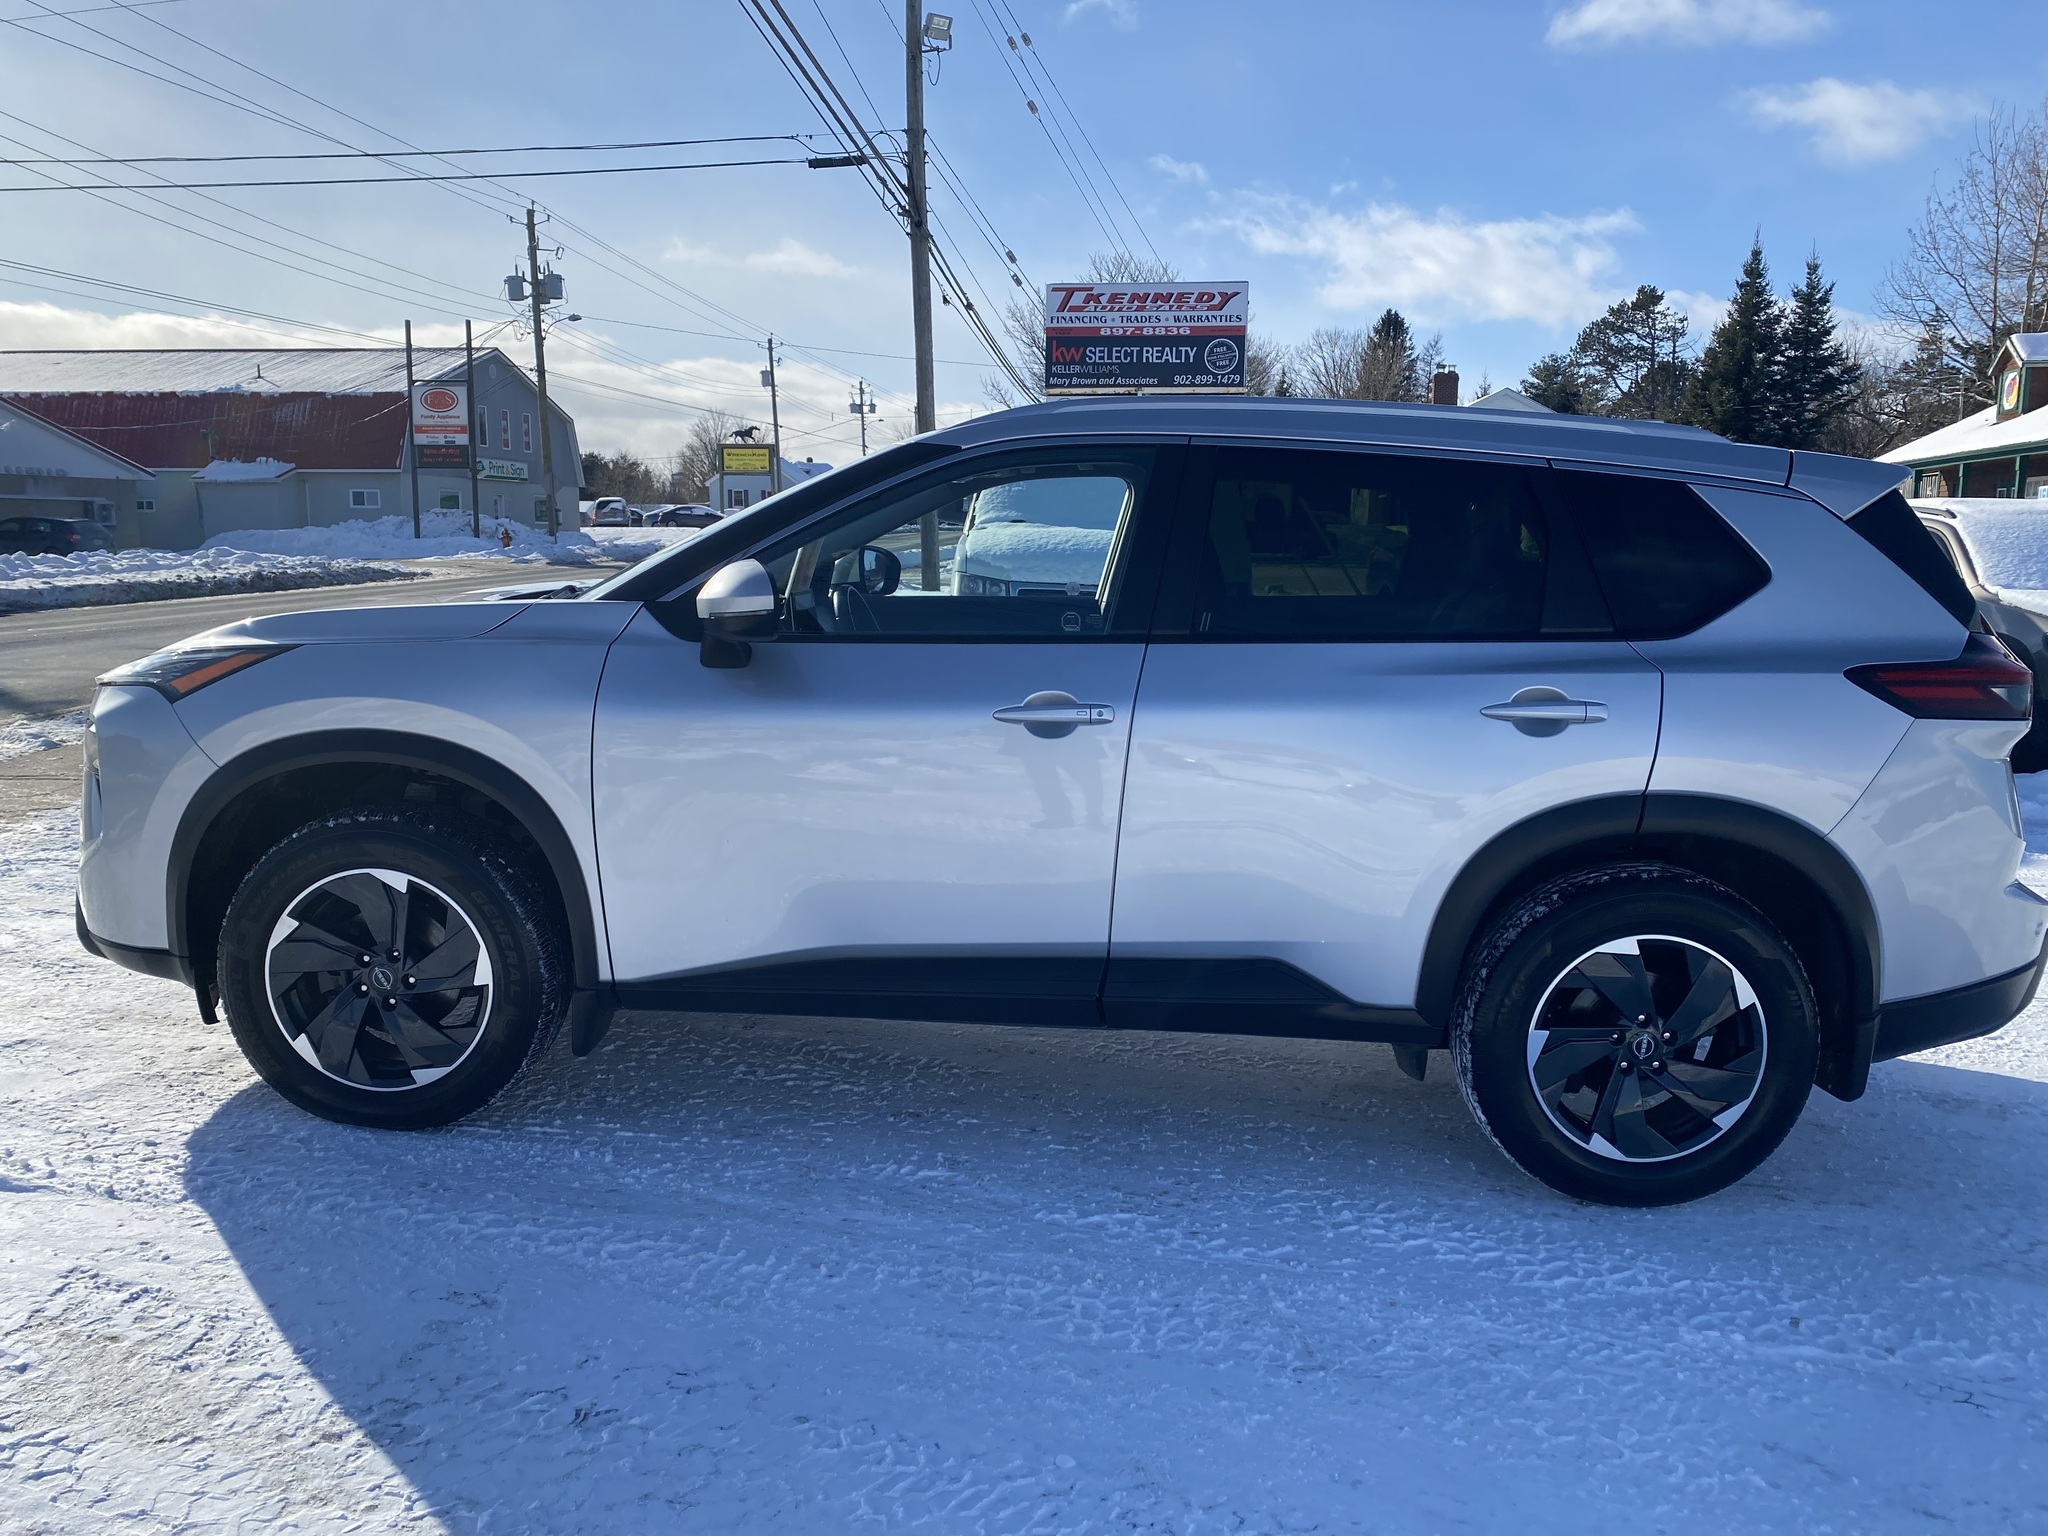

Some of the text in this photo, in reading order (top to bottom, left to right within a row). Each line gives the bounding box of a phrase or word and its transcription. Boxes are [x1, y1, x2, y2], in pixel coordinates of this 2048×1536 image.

[1050, 314, 1242, 324] FINANCING TRADES WARRANTIES
[1099, 327, 1191, 336] 897-8836
[1052, 340, 1197, 363] kw SELECT REALTY
[1049, 376, 1158, 386] Mary Brown and Associates
[1173, 374, 1240, 385] 902-899-1479
[470, 889, 522, 998] GENERAL
